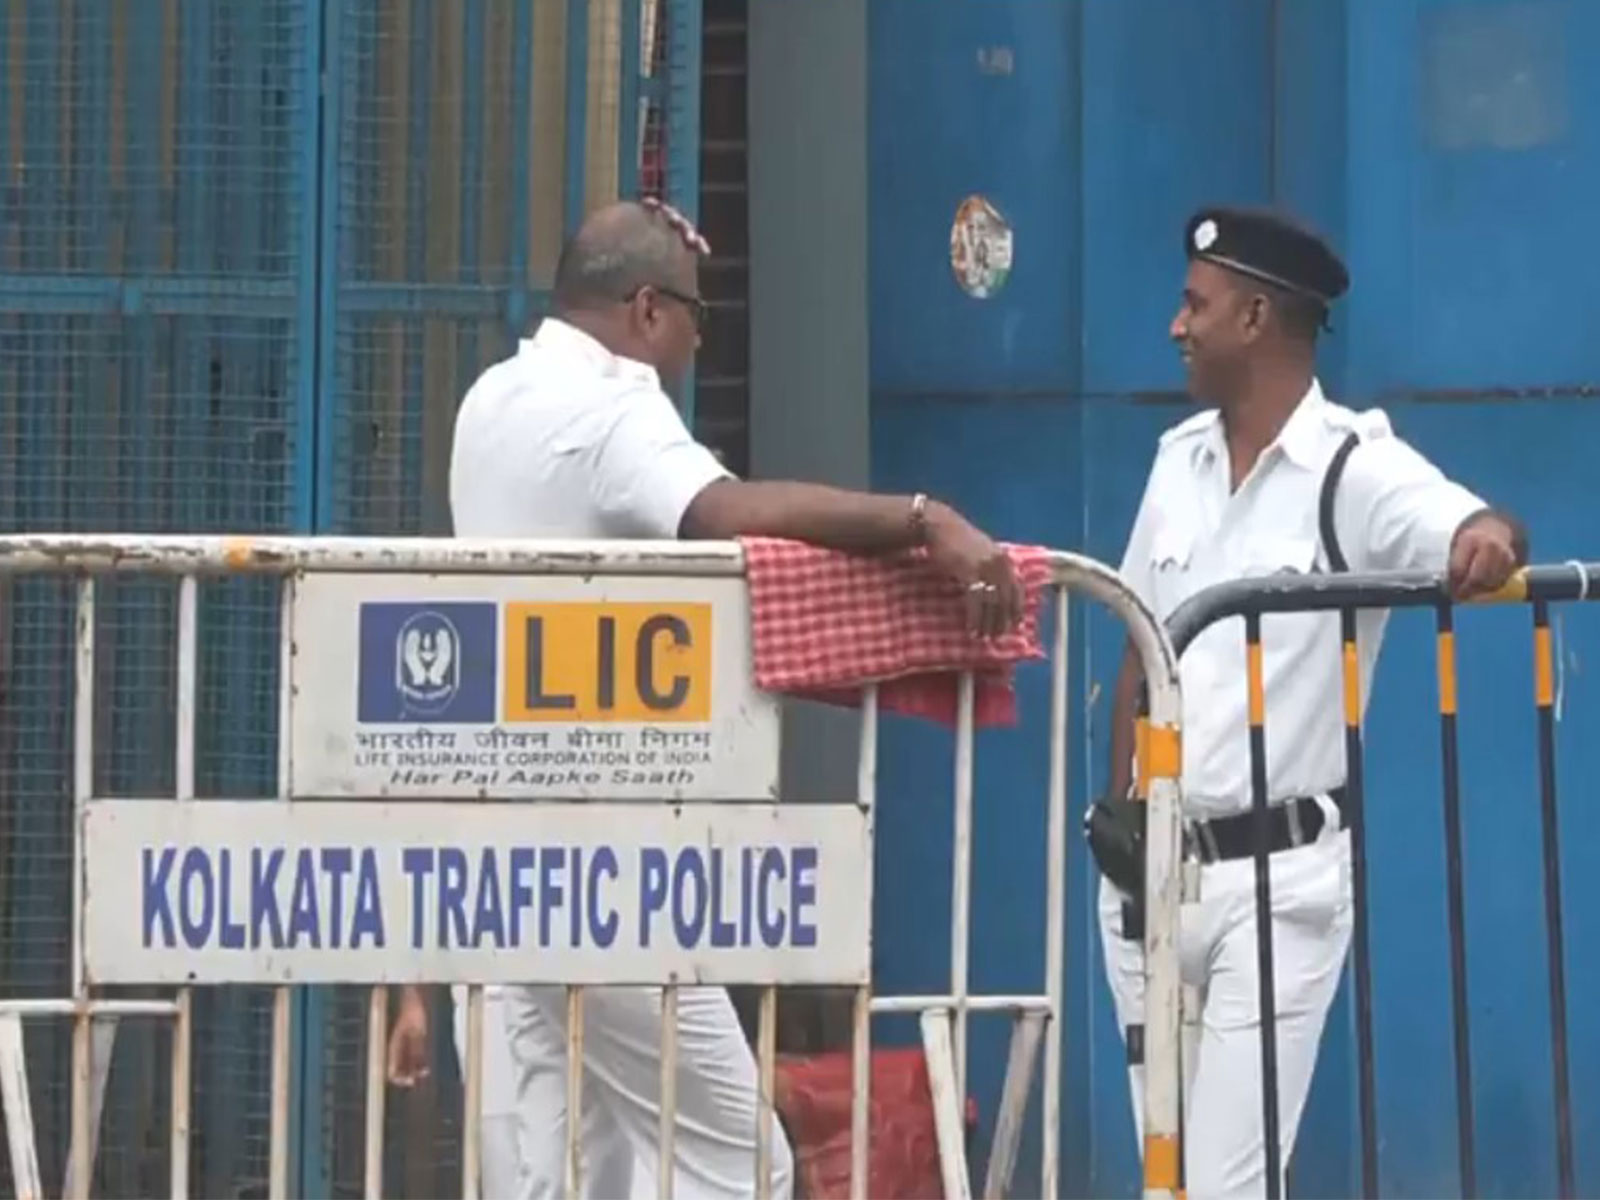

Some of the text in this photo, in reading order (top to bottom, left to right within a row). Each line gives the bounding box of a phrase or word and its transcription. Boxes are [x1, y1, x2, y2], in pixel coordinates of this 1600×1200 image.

[526, 614, 692, 710] LIC
[356, 727, 711, 749] भारतीय जीवन बीमा निगम
[355, 751, 711, 766] LIFE INSURANCE CORPORATION OF INDIA
[389, 768, 695, 786] Har Pal Aapke Saath
[141, 845, 818, 950] KOLKATA TRAFFIC POLICE
